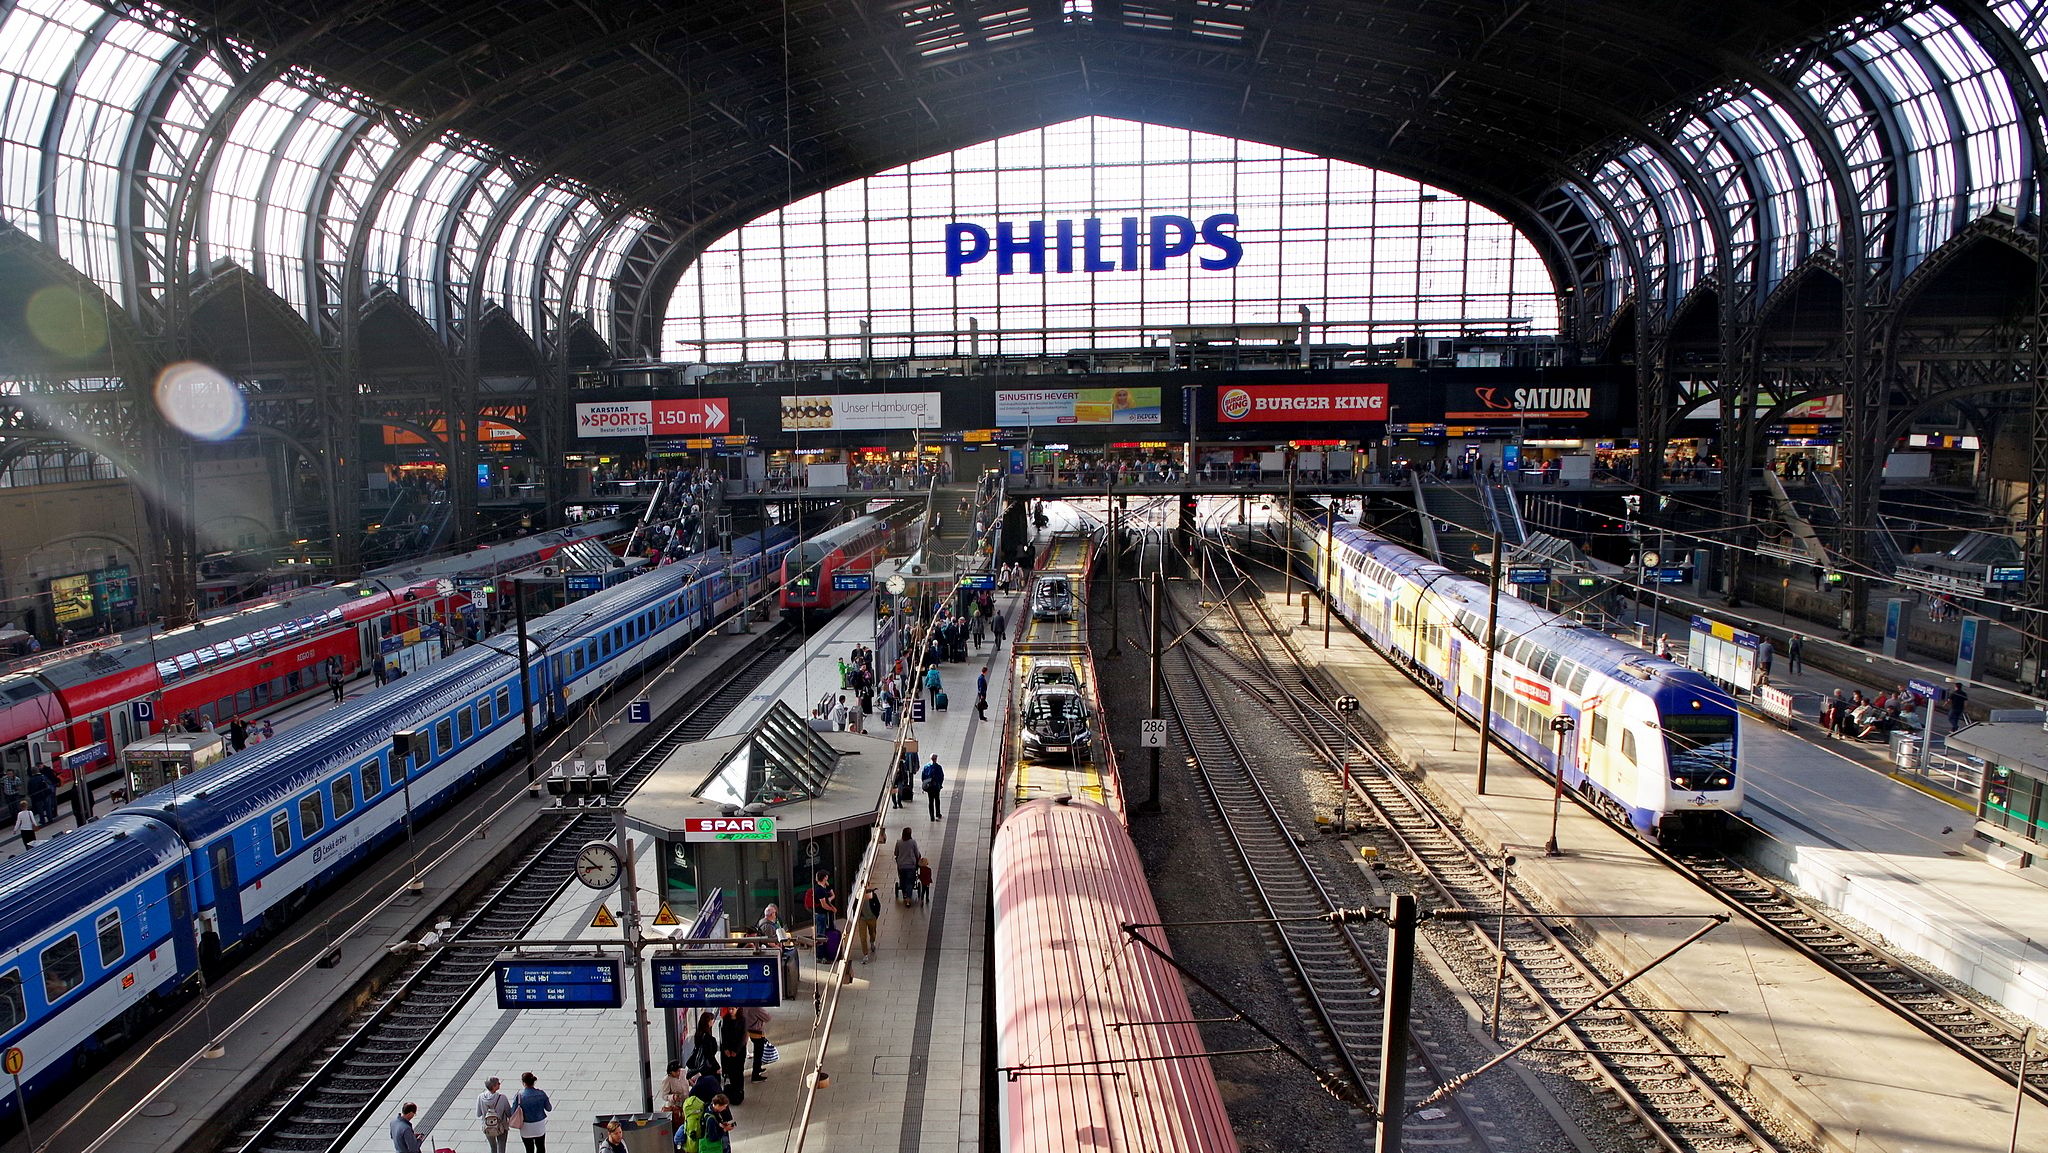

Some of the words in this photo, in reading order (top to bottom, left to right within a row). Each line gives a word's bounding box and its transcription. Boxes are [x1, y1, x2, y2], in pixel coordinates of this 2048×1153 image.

[945, 213, 1243, 277] PHILIPS
[999, 393, 1042, 401] SINUSITIS
[1044, 391, 1079, 400] HEVERT
[1225, 395, 1247, 405] BURGER
[1514, 387, 1591, 409] SATURN
[841, 402, 869, 413] Unser
[871, 400, 929, 415] Hamburger.
[1226, 400, 1248, 412] KING
[1255, 397, 1330, 410] BURGER
[1334, 396, 1382, 409] KING
[591, 412, 648, 427] SPORTS
[659, 411, 686, 424] 150
[690, 414, 702, 424] m
[564, 527, 570, 535] C
[881, 522, 887, 530] D
[473, 591, 486, 599] 286
[1910, 680, 1927, 694] Hamburg
[139, 703, 149, 717] D
[631, 703, 641, 719] E
[914, 702, 922, 718] E
[1143, 721, 1165, 733] 286
[1150, 734, 1157, 745] 6
[72, 750, 92, 765] Hamburg
[93, 747, 101, 756] Hbf
[701, 820, 754, 831] SPAR
[137, 894, 143, 904] 2
[502, 967, 510, 979] 7
[763, 964, 770, 976] 8
[10, 1053, 18, 1069] T
